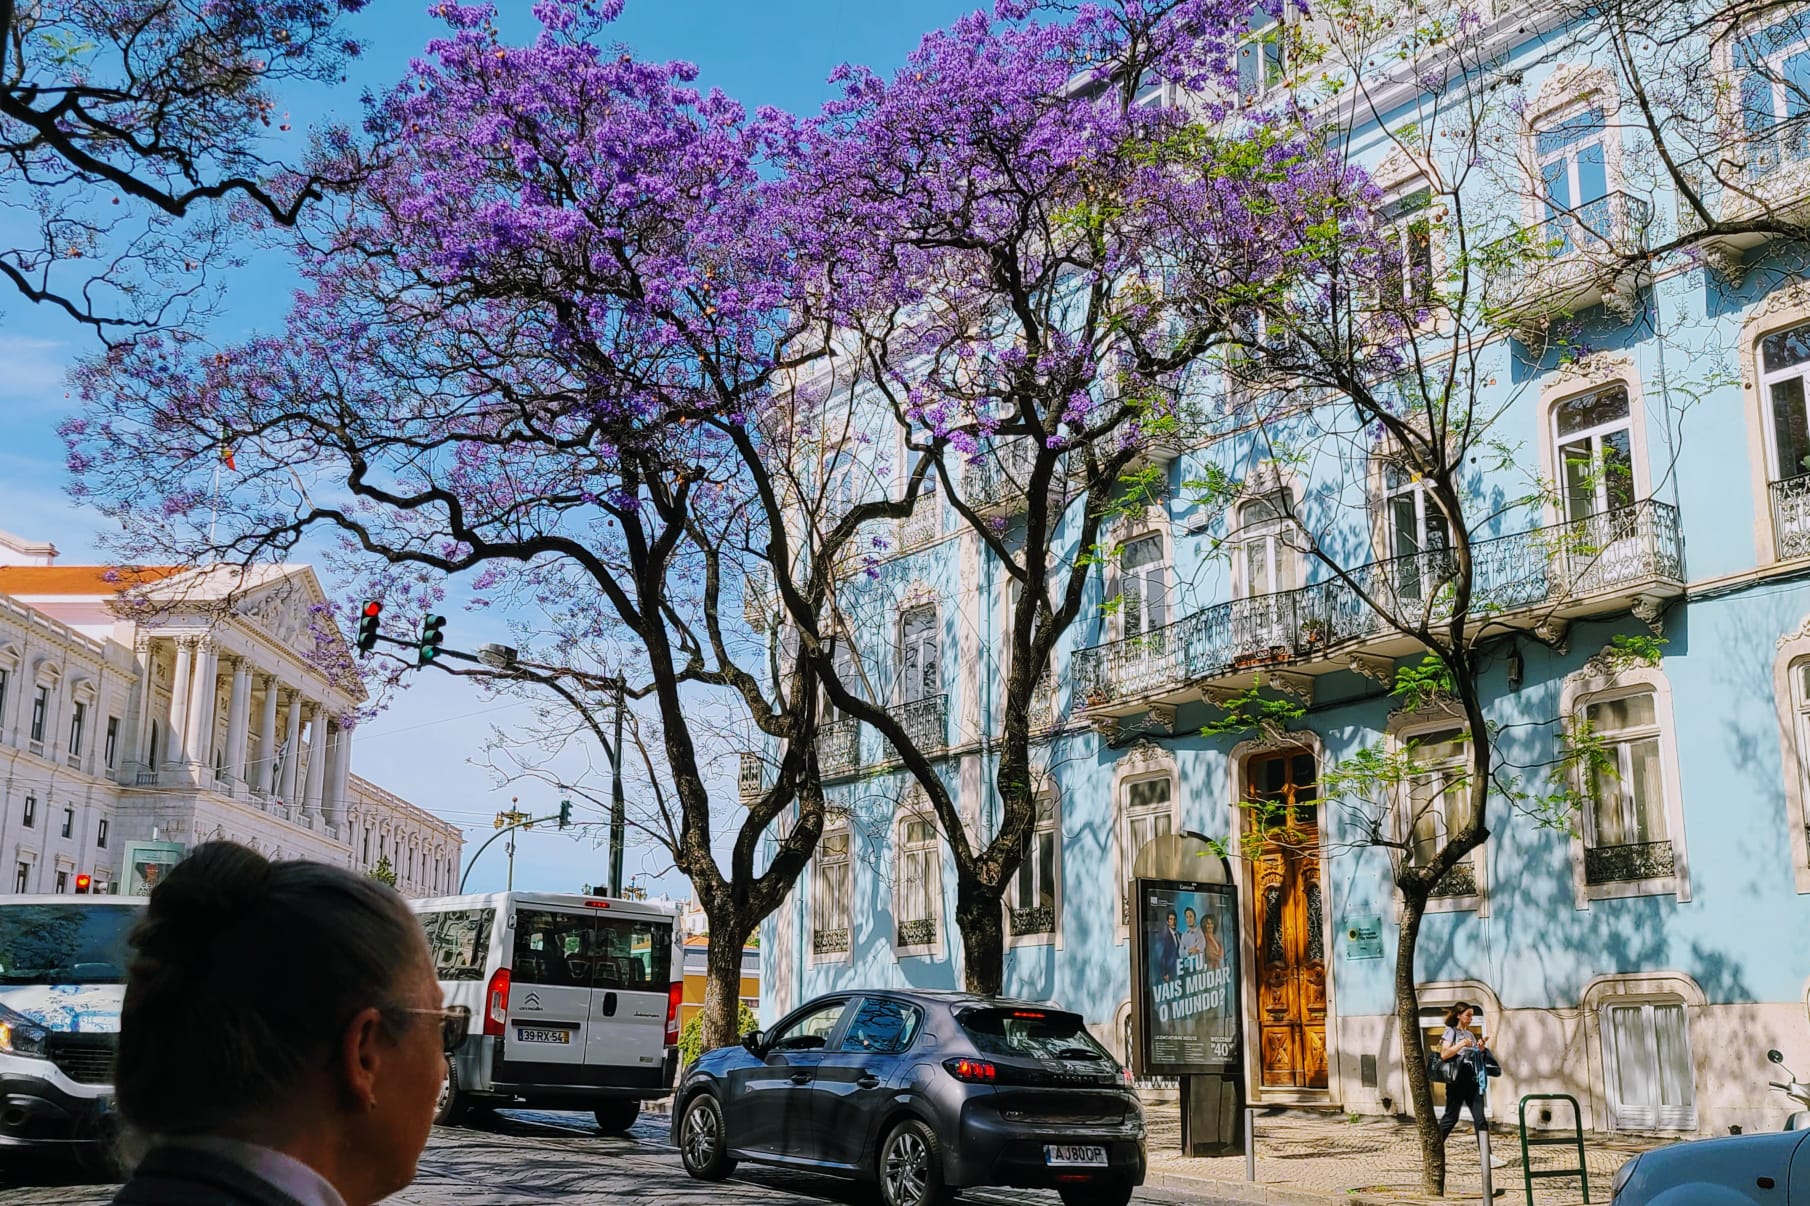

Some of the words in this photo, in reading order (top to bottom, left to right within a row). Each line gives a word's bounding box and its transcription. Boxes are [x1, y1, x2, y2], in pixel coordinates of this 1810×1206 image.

[1176, 958, 1185, 976] E
[1188, 952, 1208, 973] TU,
[1152, 979, 1183, 1003] VAIS
[1185, 966, 1231, 995] MUDAR
[1159, 1004, 1169, 1022] O
[1172, 988, 1226, 1020] MUNDO?
[1214, 1043, 1229, 1056] 40
